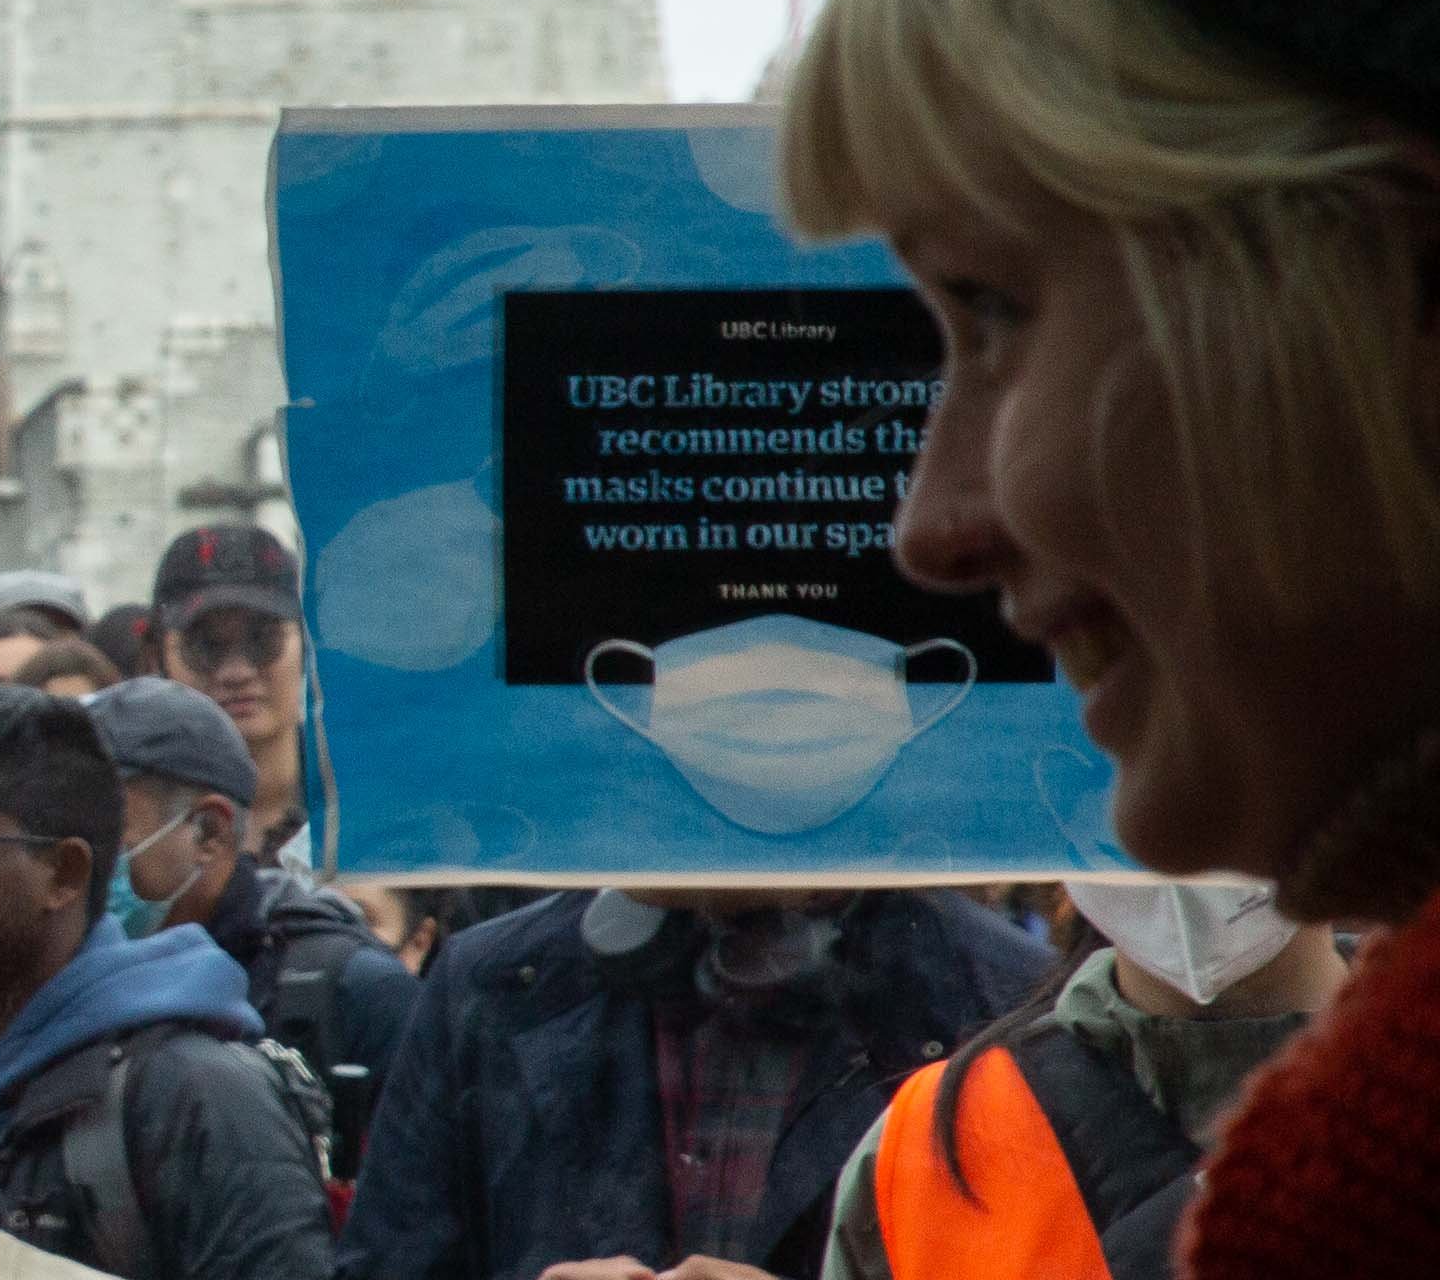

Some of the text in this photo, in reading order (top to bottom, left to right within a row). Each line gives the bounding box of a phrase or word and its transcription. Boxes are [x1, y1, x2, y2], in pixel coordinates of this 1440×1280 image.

[721, 321, 836, 342] UBC Library
[567, 373, 949, 414] UBC Library strong
[598, 420, 865, 455] recommends
[563, 468, 694, 503] masks
[701, 468, 885, 502] continue
[583, 517, 895, 557] worn in our spa
[719, 583, 838, 600] THANK YOU
